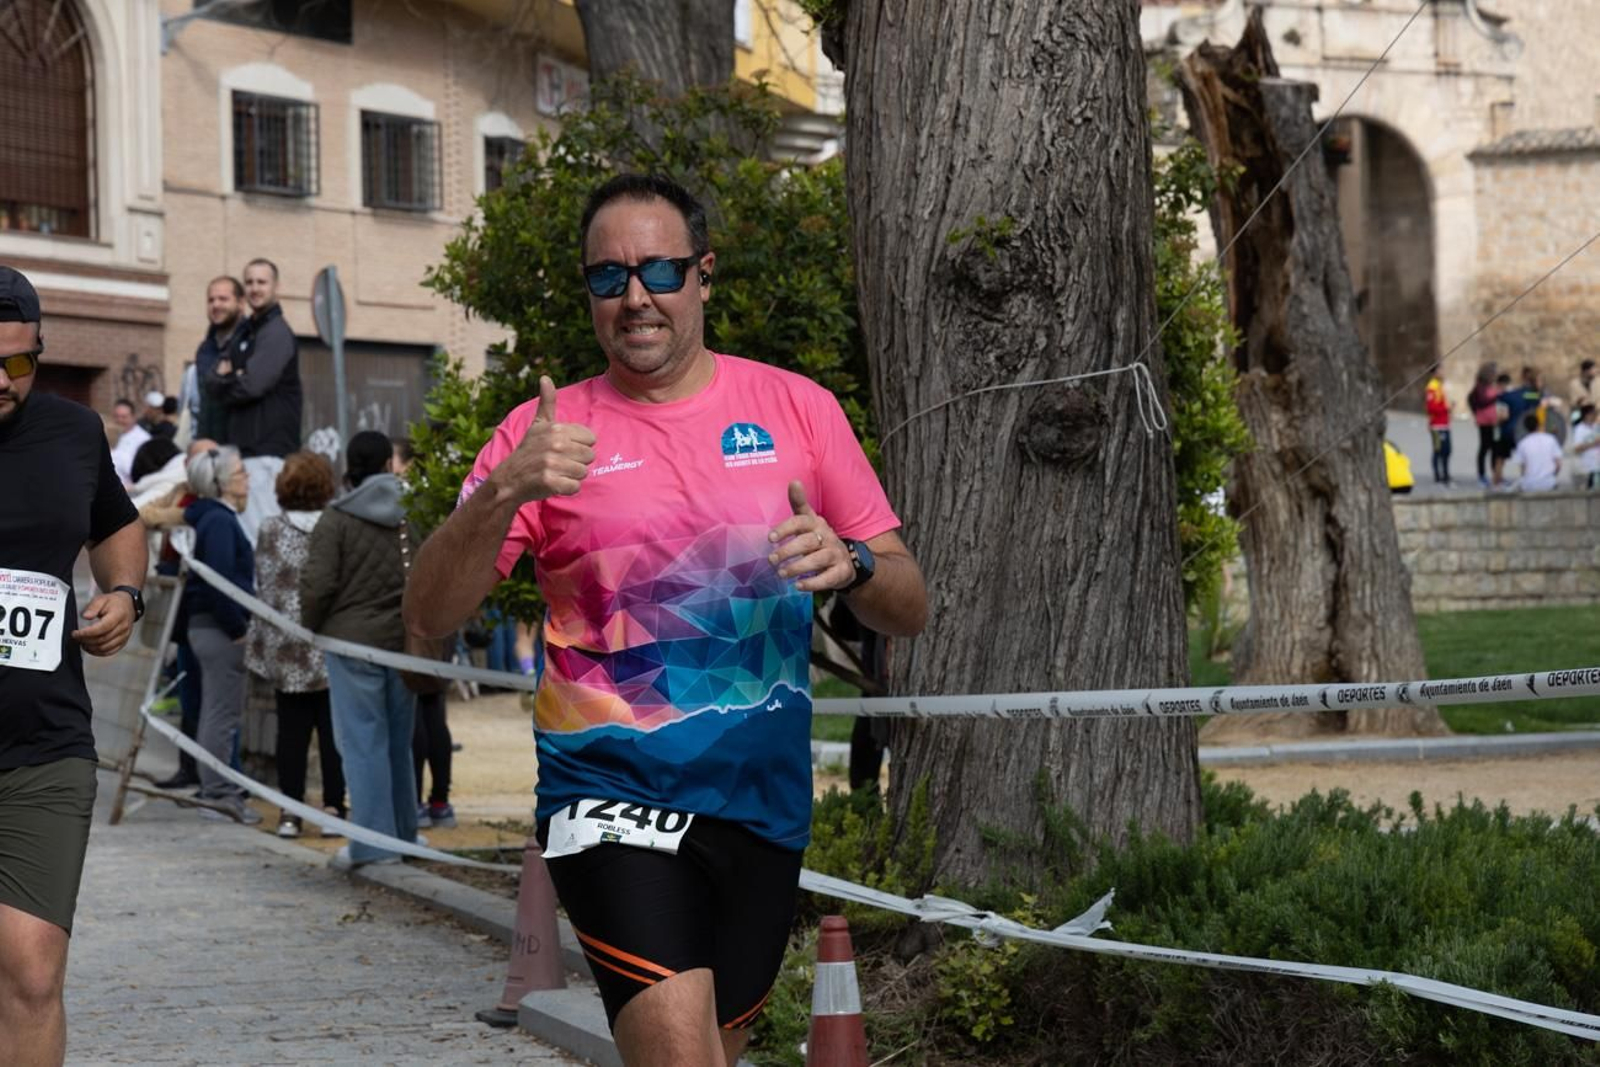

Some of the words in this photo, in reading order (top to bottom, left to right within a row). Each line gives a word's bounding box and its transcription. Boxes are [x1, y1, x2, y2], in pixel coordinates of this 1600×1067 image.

[592, 459, 645, 477] TEAMERGY
[1159, 699, 1202, 713] DEPORTES
[1280, 693, 1290, 707] de
[1337, 686, 1386, 703] DEPORTES
[1420, 681, 1476, 699] Ayuntamiento
[1478, 678, 1489, 692] de
[1491, 677, 1512, 691] Jaén
[597, 822, 631, 835] ROBLESS
